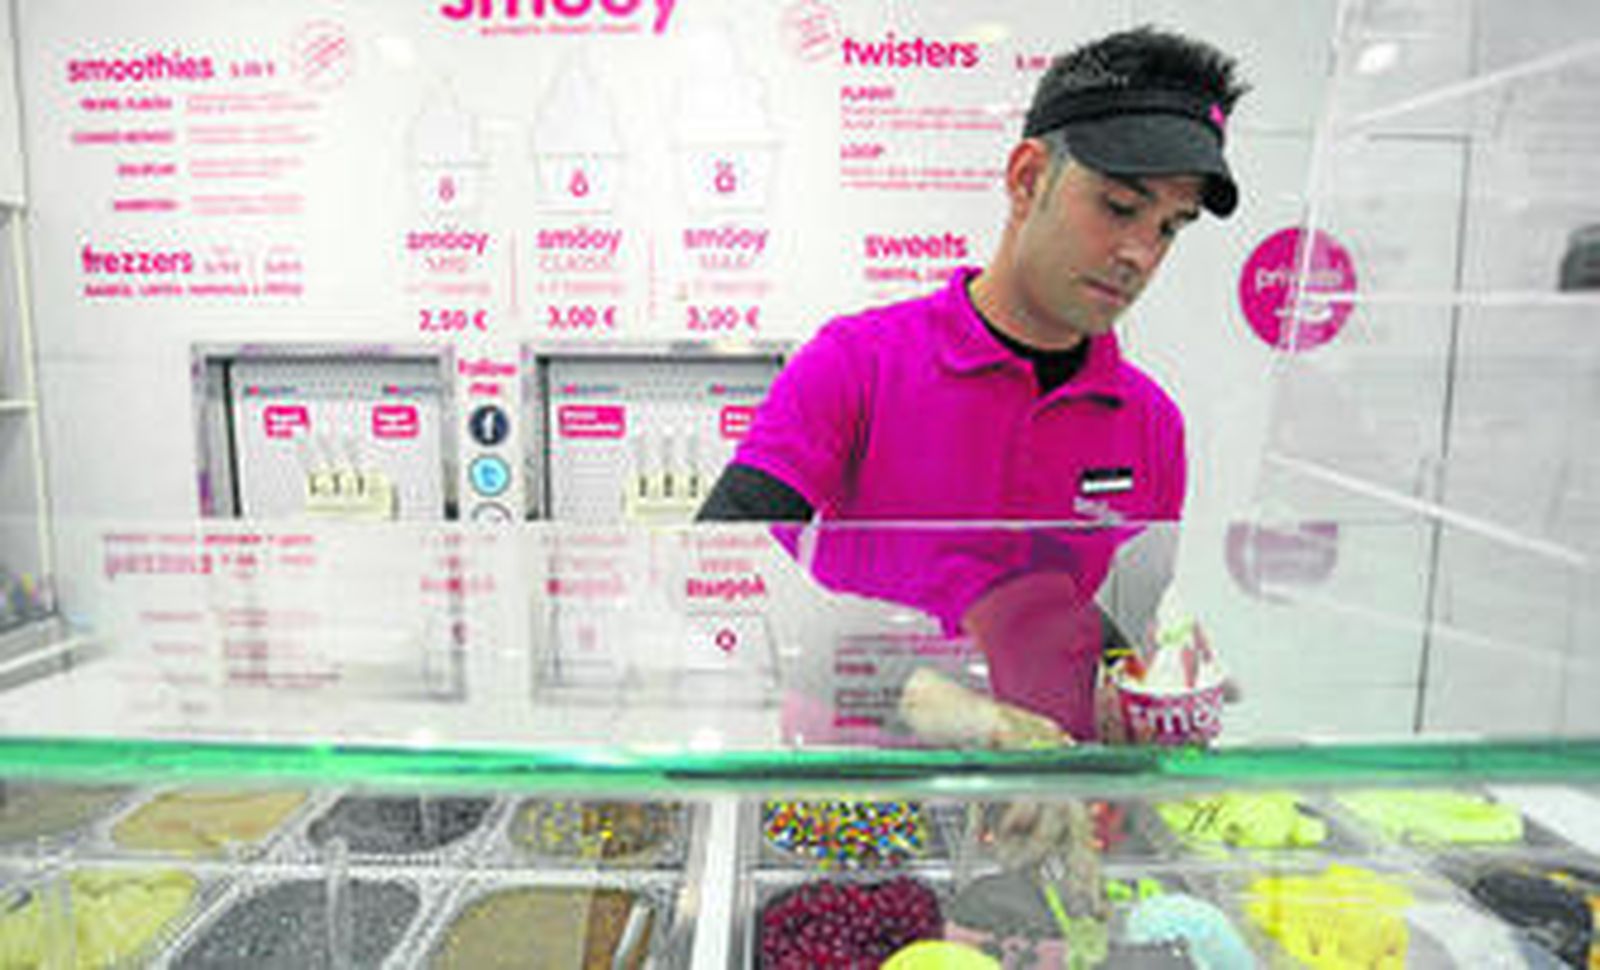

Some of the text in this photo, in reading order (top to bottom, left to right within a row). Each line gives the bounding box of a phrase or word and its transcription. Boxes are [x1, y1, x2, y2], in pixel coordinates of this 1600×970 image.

[67, 50, 214, 83] smoothies
[842, 33, 979, 68] twisters
[864, 231, 968, 258] sweets
